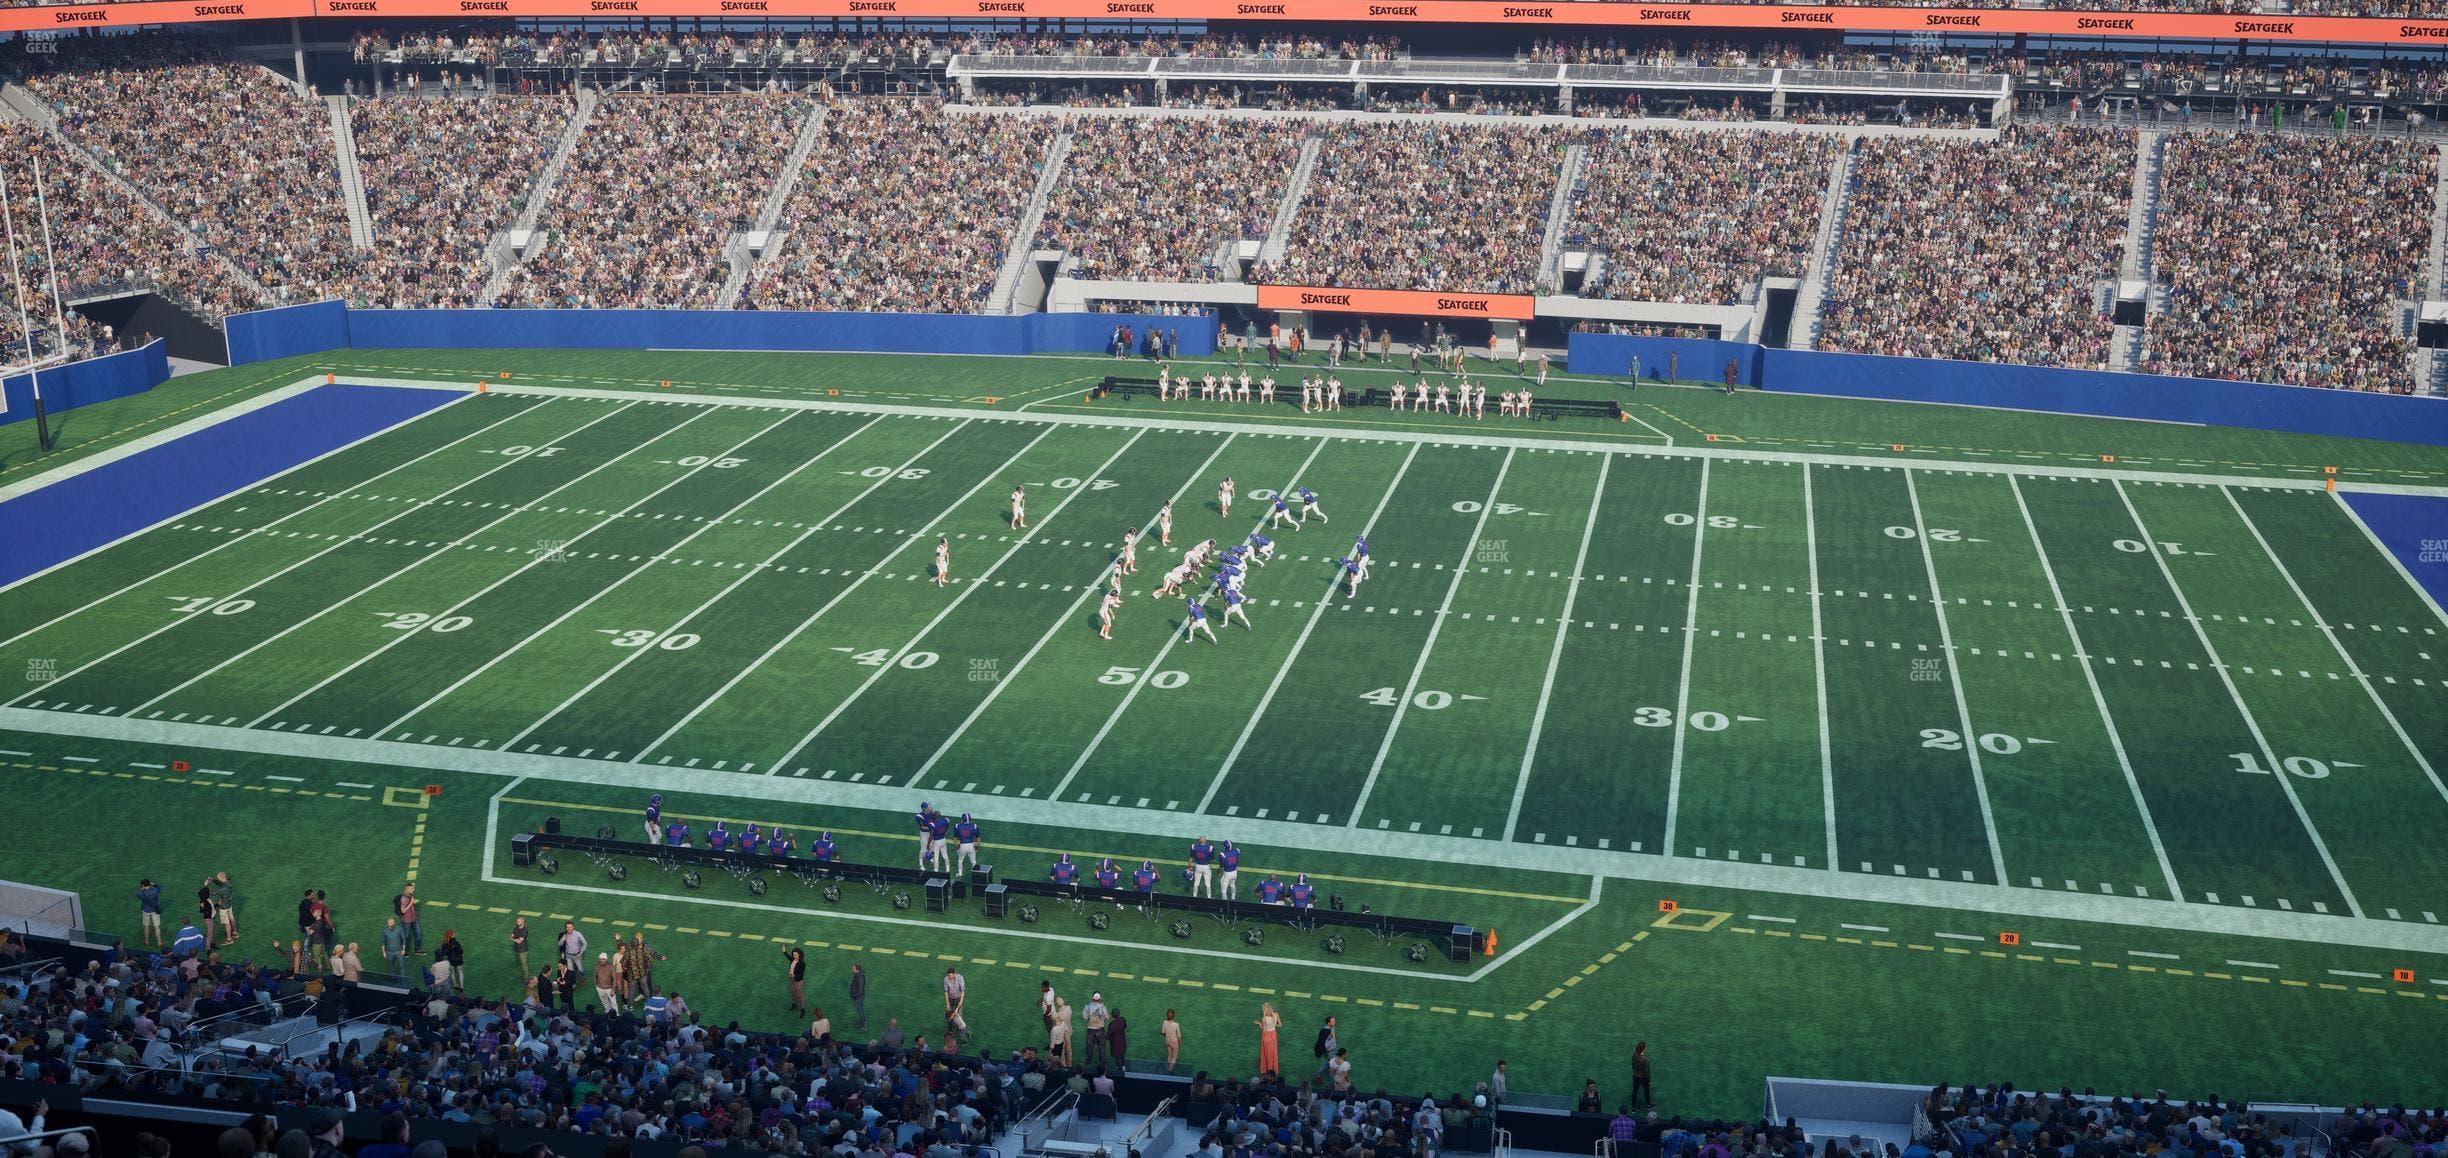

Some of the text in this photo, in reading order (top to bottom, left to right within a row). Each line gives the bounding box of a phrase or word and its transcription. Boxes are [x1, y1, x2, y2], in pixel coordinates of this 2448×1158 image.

[194, 4, 244, 16] SEATGEEK
[329, 1, 376, 11] SEATGEEK
[460, 1, 508, 11] SEATGEEK
[591, 1, 638, 11] SEATGEEK
[720, 1, 767, 11] SEATGEEK
[849, 1, 895, 11] SEATGEEK
[978, 2, 1025, 12] SEATGEEK
[1107, 3, 1154, 13] SEATGEEK
[1237, 4, 1285, 14] SEATGEEK
[1369, 6, 1417, 16] SEATGEEK
[1503, 7, 1553, 18] SEATGEEK
[56, 10, 107, 23] SEATGEEK
[1640, 10, 1691, 21] SEATGEEK
[1781, 12, 1834, 23] SEATGEEK
[1926, 15, 1981, 26] SEATGEEK
[2077, 18, 2134, 30] SEATGEEK
[2234, 21, 2294, 34] SEATGEEK
[1302, 293, 1350, 306] SEATGEEK
[1437, 298, 1488, 312] SEATGEEK
[500, 445, 566, 457] 10
[678, 455, 748, 469] 20
[861, 466, 930, 479] 30
[1051, 477, 1120, 490] 40
[1452, 500, 1524, 515] 40
[1664, 513, 1738, 528] 30
[1884, 525, 1961, 541] 20
[2113, 539, 2188, 555] 10
[170, 597, 256, 615] 10
[381, 612, 473, 632] 20
[611, 629, 701, 650] 30
[851, 649, 939, 669] 40
[1097, 666, 1190, 689] 50
[1359, 687, 1452, 710] 40
[1633, 706, 1730, 731] 30
[1920, 728, 2021, 754] 20
[2228, 752, 2330, 779] 10
[1663, 902, 1673, 910] 30
[2004, 934, 2014, 943] 20
[2400, 971, 2409, 980] 10
